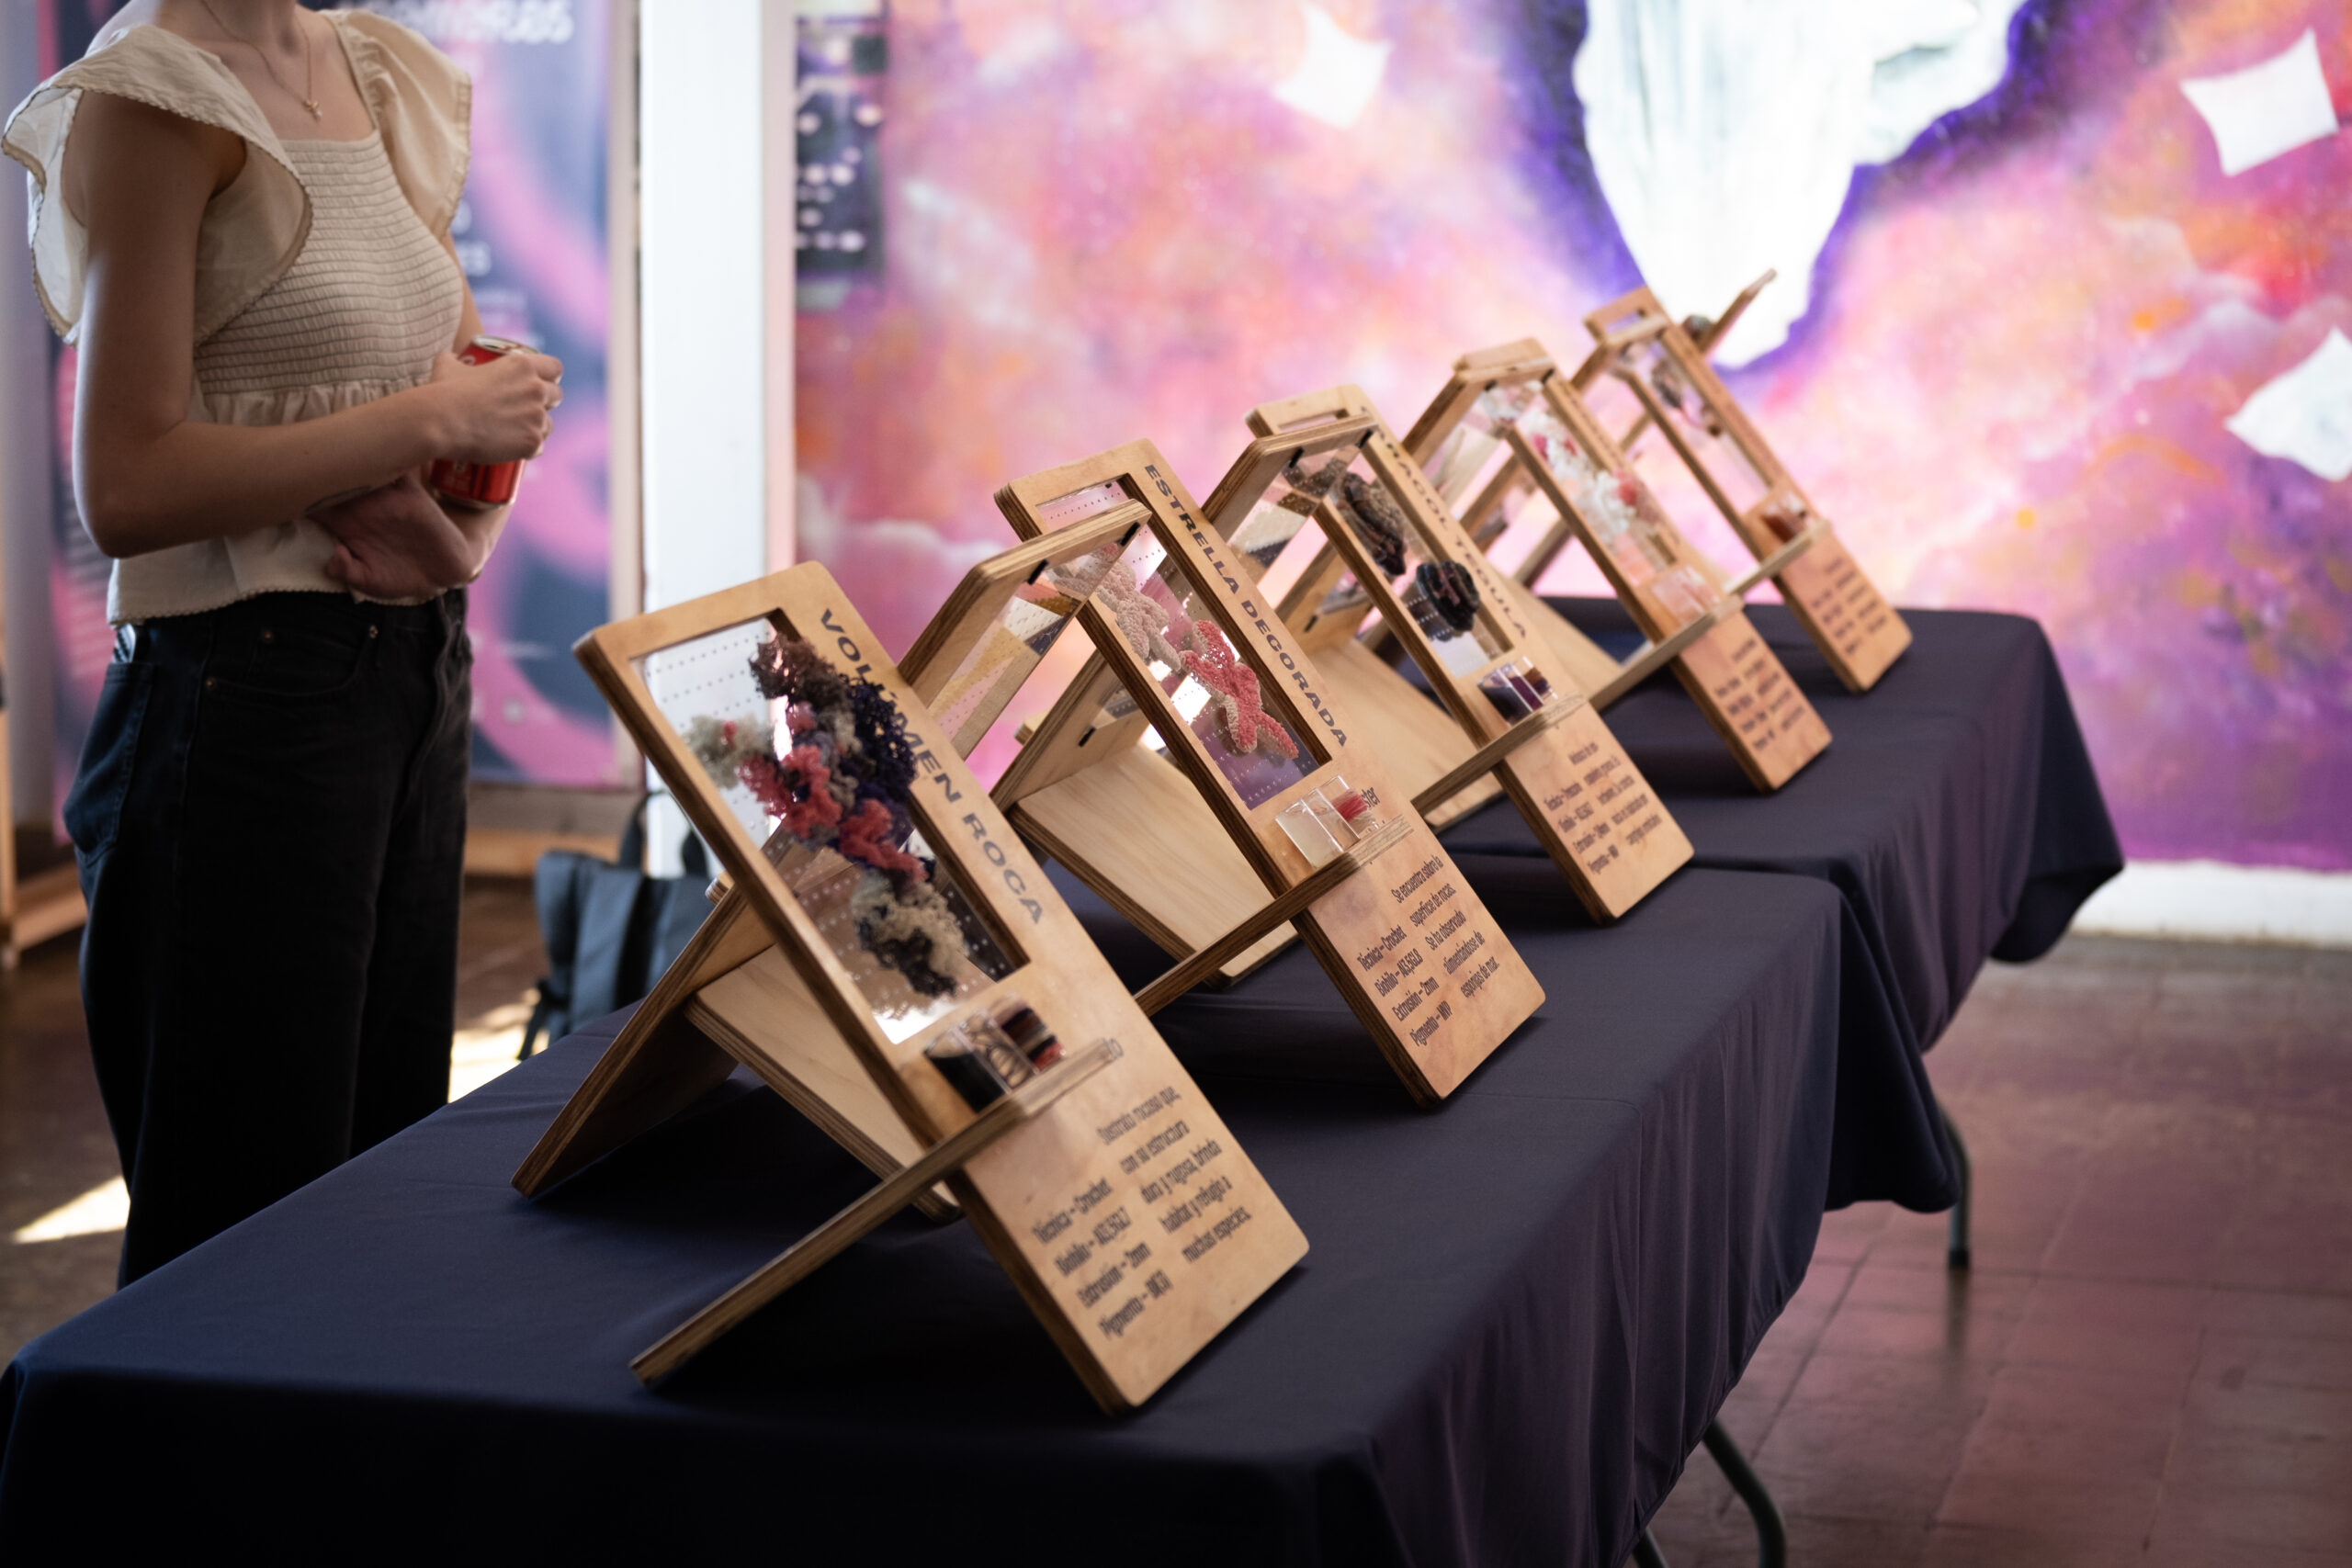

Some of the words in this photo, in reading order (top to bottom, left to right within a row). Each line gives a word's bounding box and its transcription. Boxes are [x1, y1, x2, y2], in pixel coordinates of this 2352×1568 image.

[1144, 464, 1239, 595] ESTRELLA
[1240, 599, 1347, 748] DECORADA
[961, 812, 1043, 924] ROCA
[1398, 870, 1427, 898] encuentra
[1408, 898, 1437, 928] superficie
[1439, 908, 1467, 940] observado
[1356, 946, 1385, 972] Técnica
[1380, 924, 1408, 952] Crochet
[1442, 937, 1480, 976] alimentándose
[1374, 970, 1399, 998] Biohilo
[1460, 970, 1486, 998] esponjas
[1391, 989, 1423, 1022] Extrusión
[1408, 1015, 1440, 1047] Pigmento
